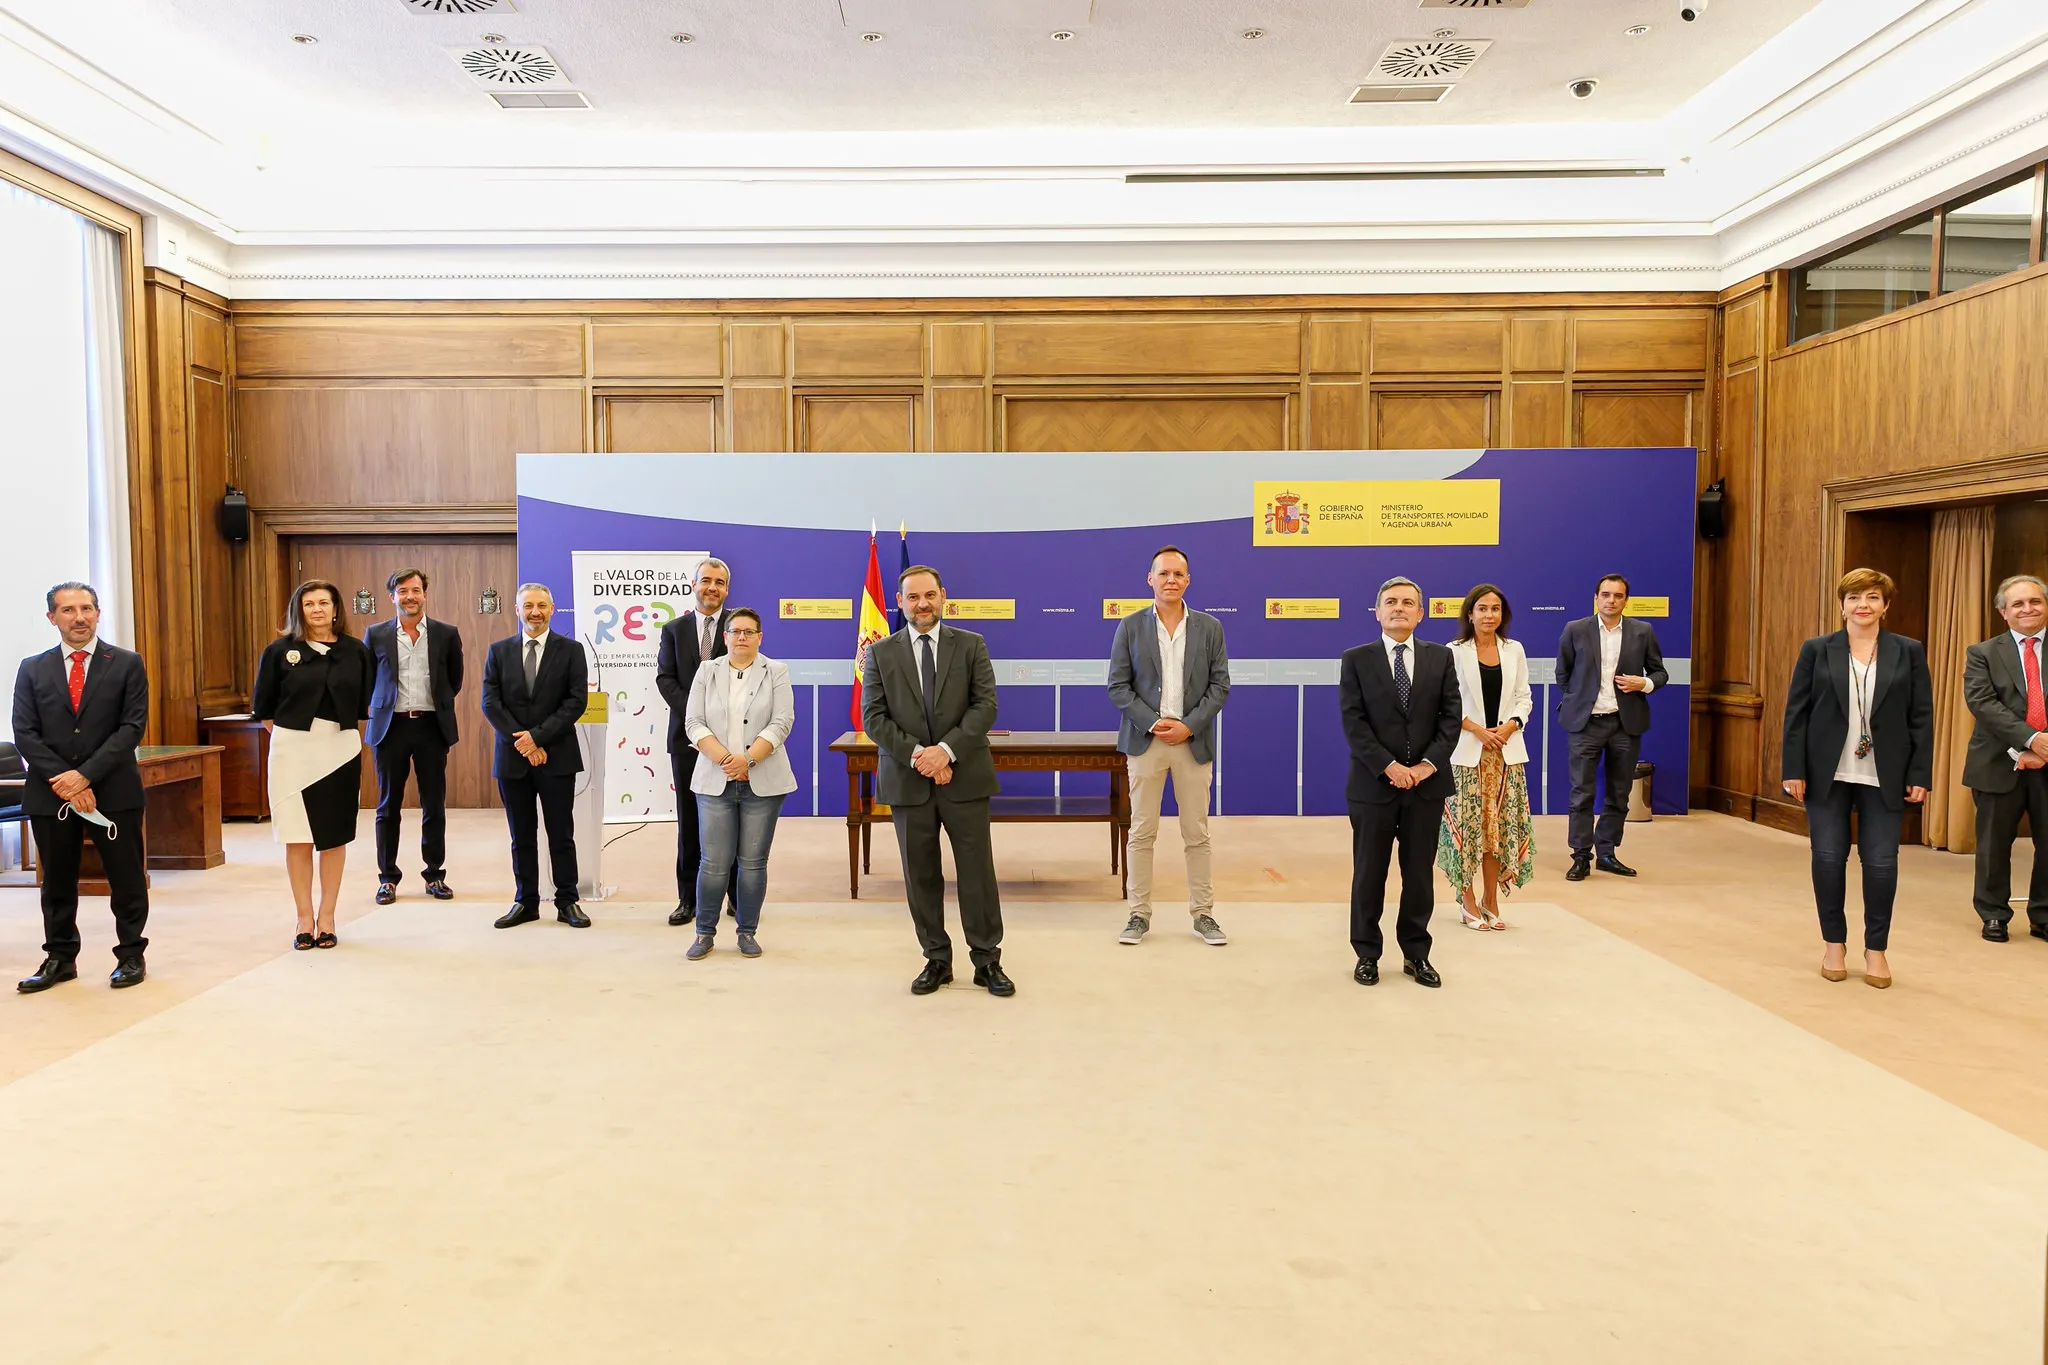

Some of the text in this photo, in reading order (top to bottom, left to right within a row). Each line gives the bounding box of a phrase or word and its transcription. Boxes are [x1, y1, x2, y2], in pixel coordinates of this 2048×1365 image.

[1319, 504, 1364, 512] GOBIERNO
[1319, 511, 1364, 520] DE ESPAÑA
[593, 569, 688, 581] EL VALOR DE LA
[593, 584, 692, 596] DIVERSIDAD
[594, 601, 690, 645] RED
